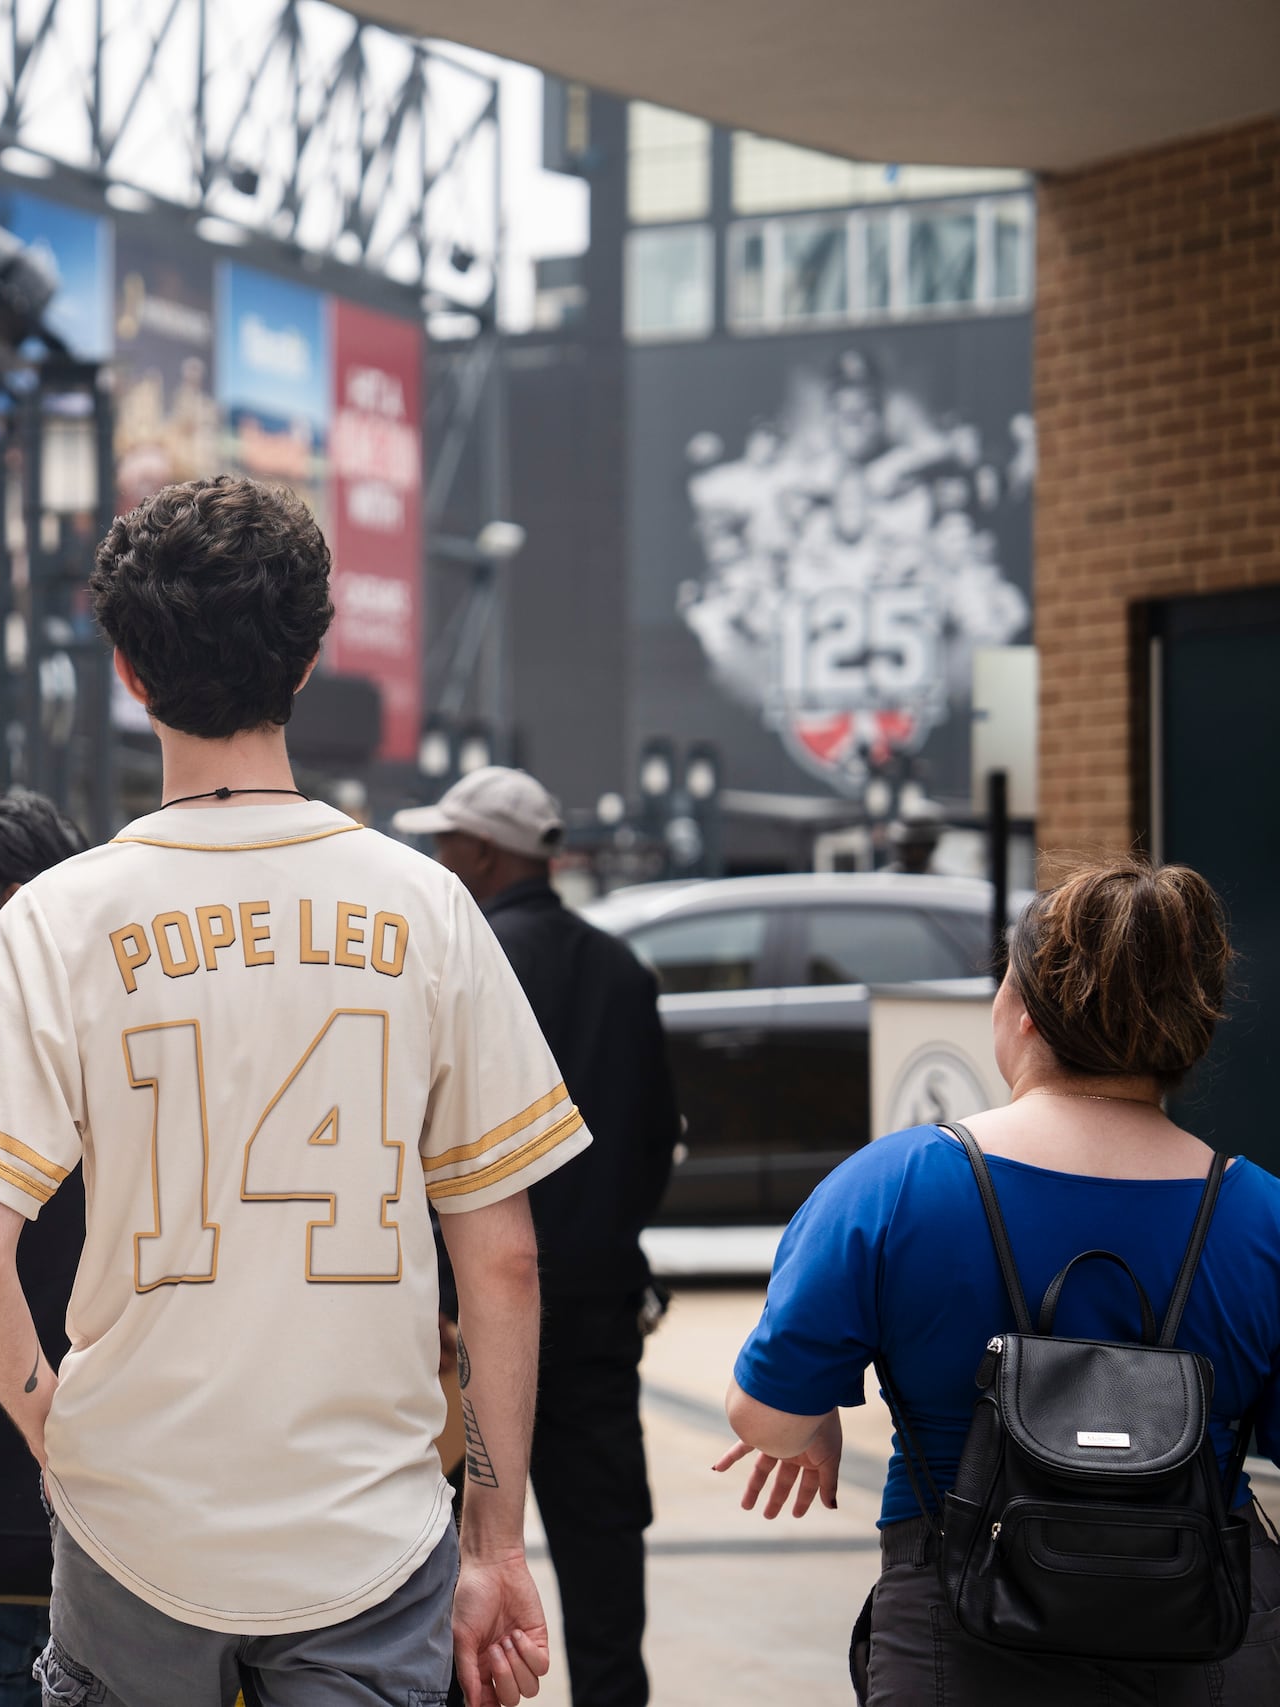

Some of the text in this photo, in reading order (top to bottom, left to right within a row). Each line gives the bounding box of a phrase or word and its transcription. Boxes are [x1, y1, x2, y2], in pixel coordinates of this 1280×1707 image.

[778, 591, 926, 695] 125
[109, 899, 410, 994] POPE LEO
[122, 1008, 405, 1293] 14
